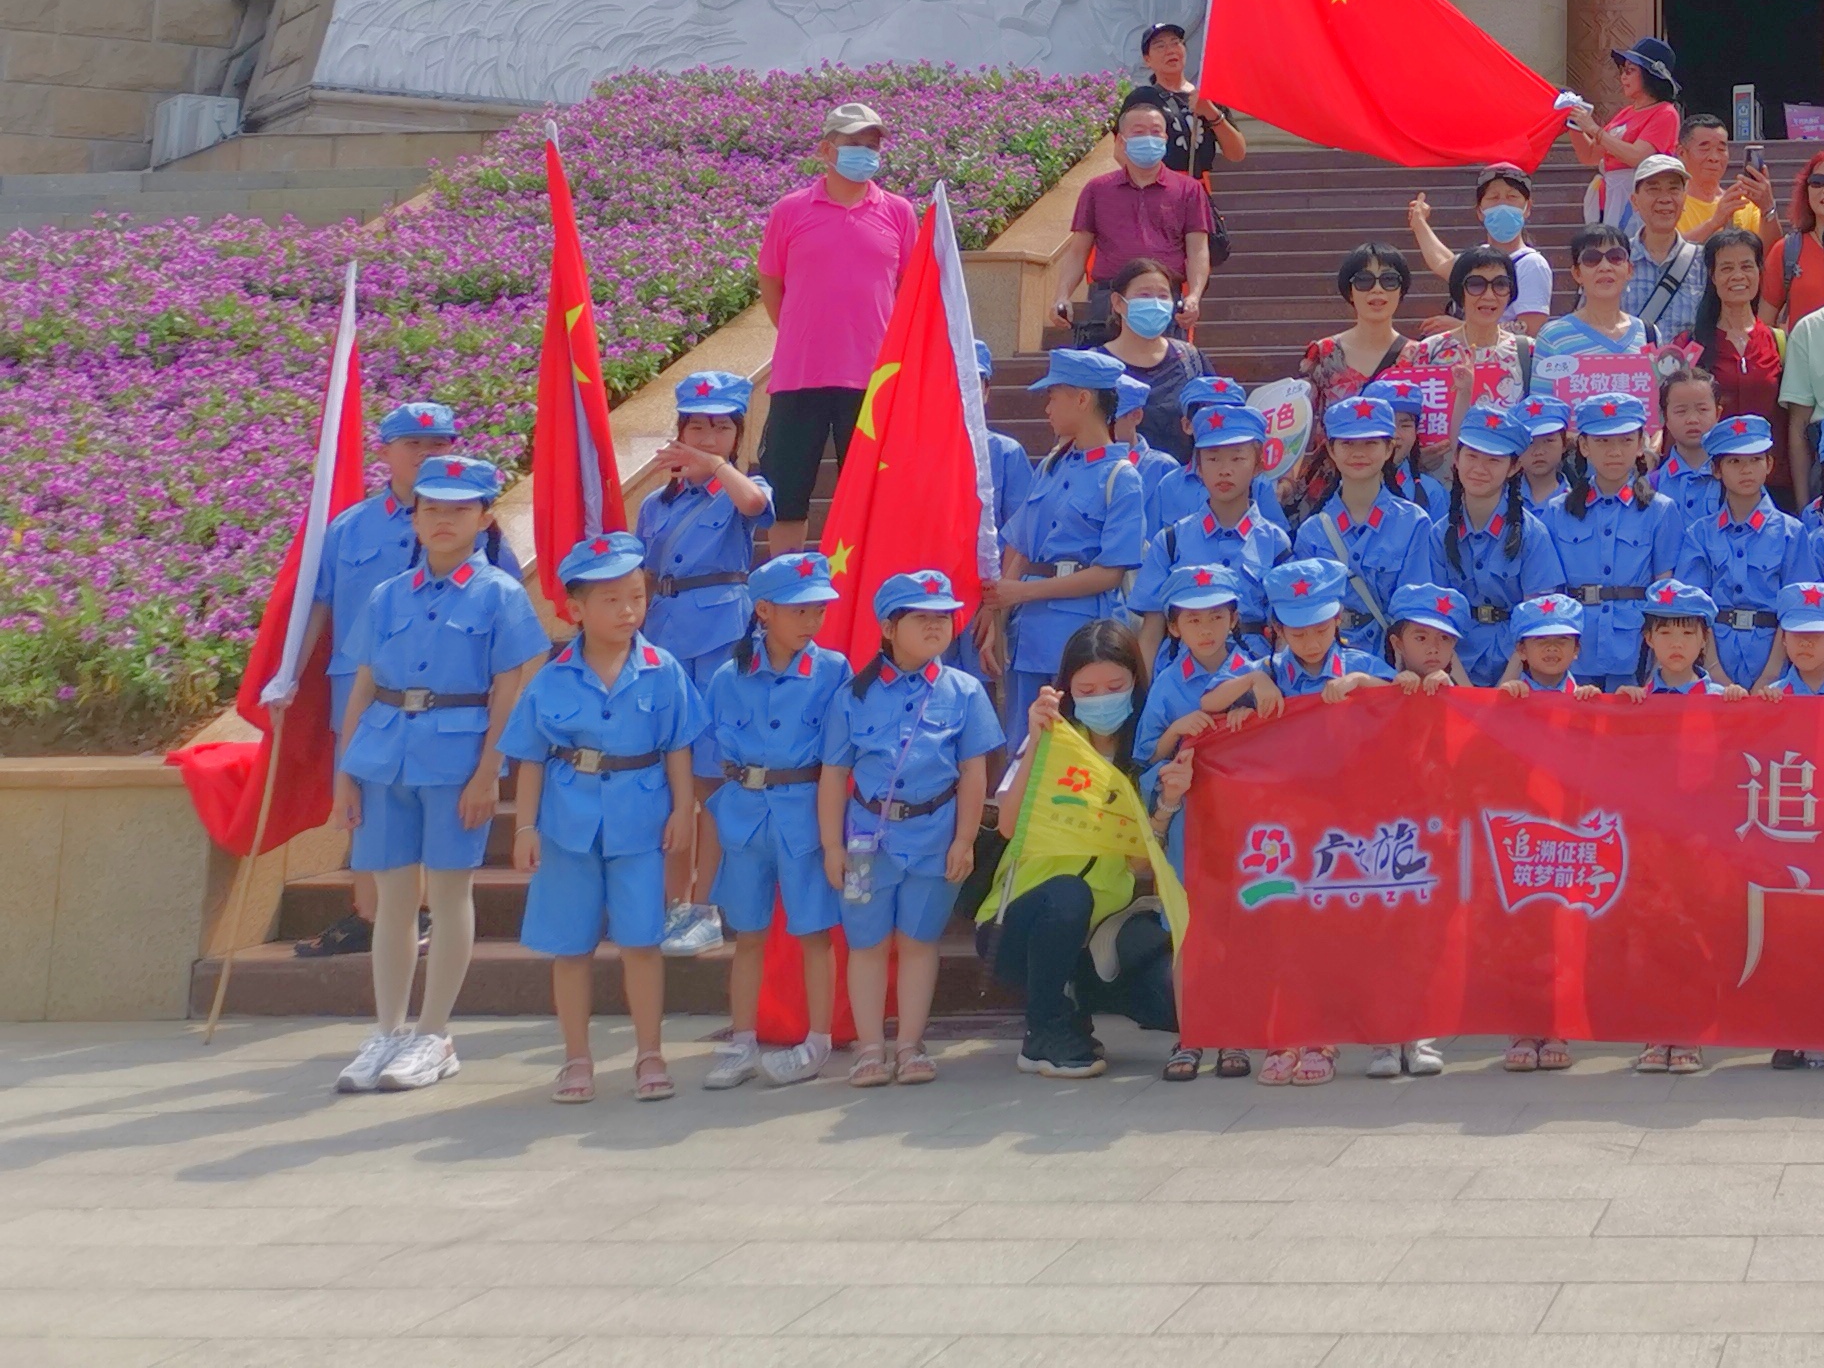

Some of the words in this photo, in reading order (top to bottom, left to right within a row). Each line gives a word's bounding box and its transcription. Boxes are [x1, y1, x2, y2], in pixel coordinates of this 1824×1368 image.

[1569, 373, 1651, 394] 致敬建党
[1314, 823, 1428, 881] 广之旅
[1502, 827, 1598, 864] 追溯征程
[1512, 864, 1616, 899] 筑梦前行
